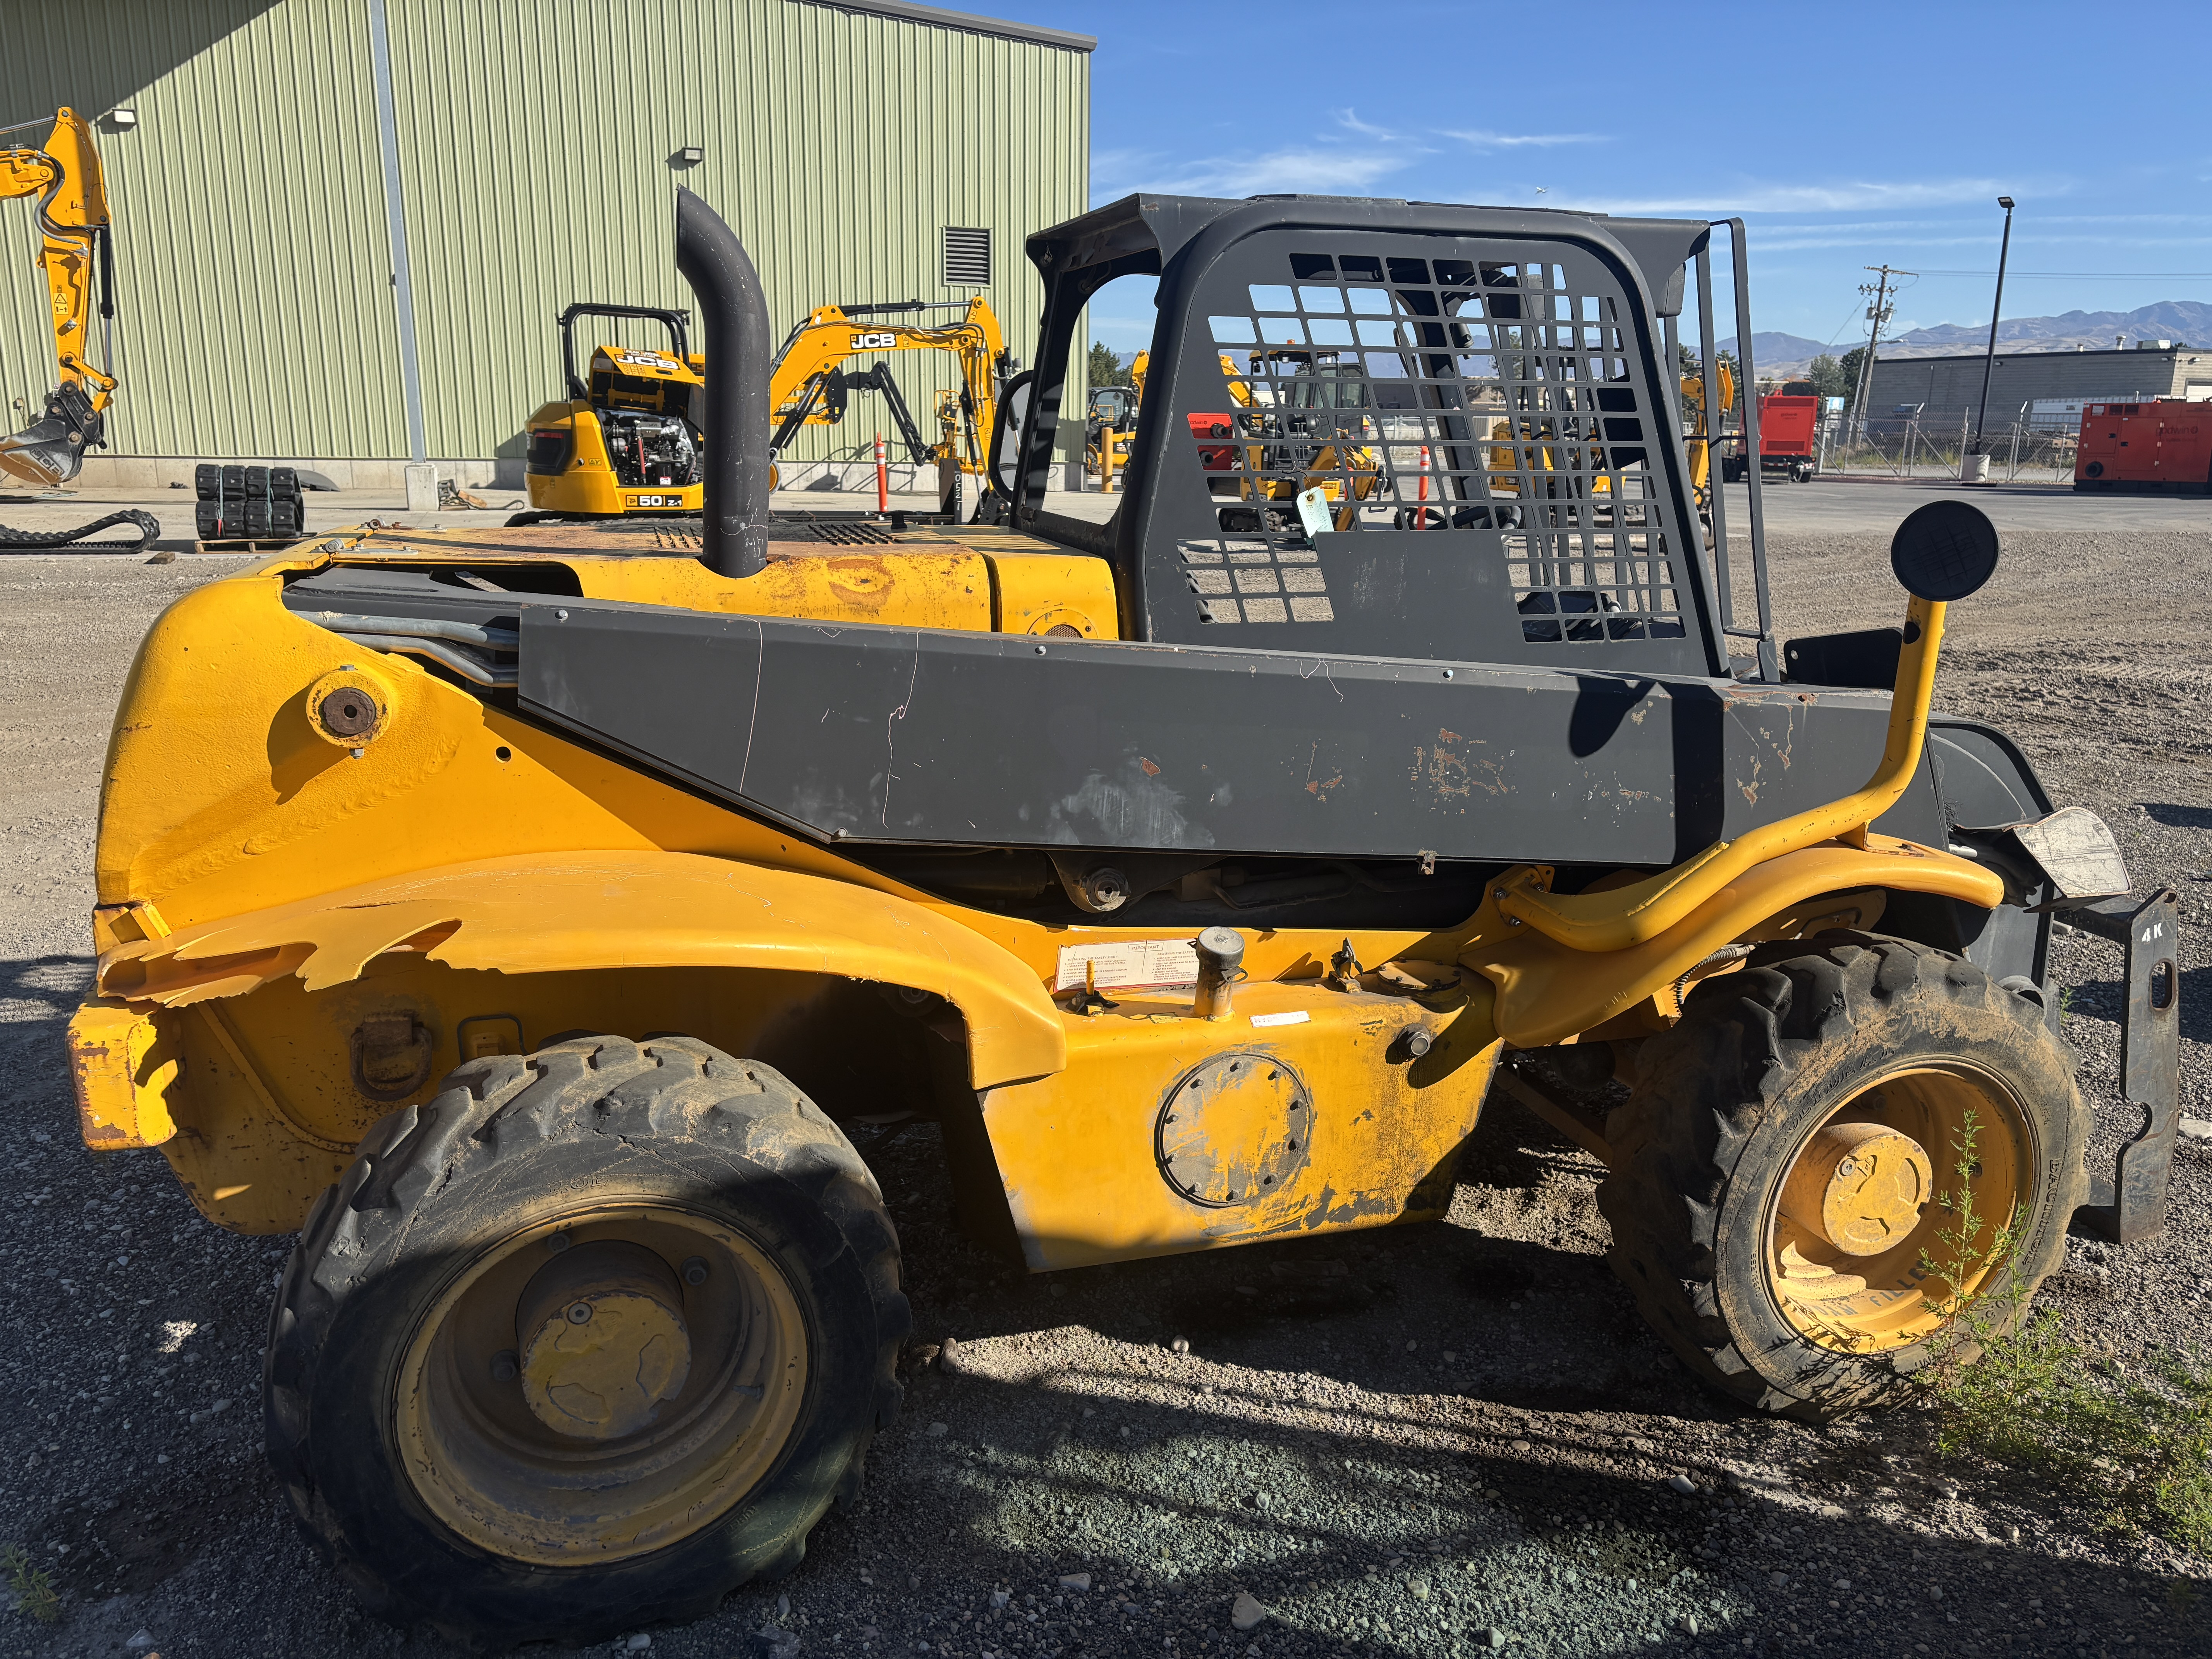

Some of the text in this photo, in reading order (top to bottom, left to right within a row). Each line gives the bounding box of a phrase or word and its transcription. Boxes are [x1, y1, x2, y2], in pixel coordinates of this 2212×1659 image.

[851, 333, 896, 349] JCB
[617, 355, 679, 369] JCB
[639, 496, 662, 506] 50
[1751, 1252, 1760, 1298] TUBELESS
